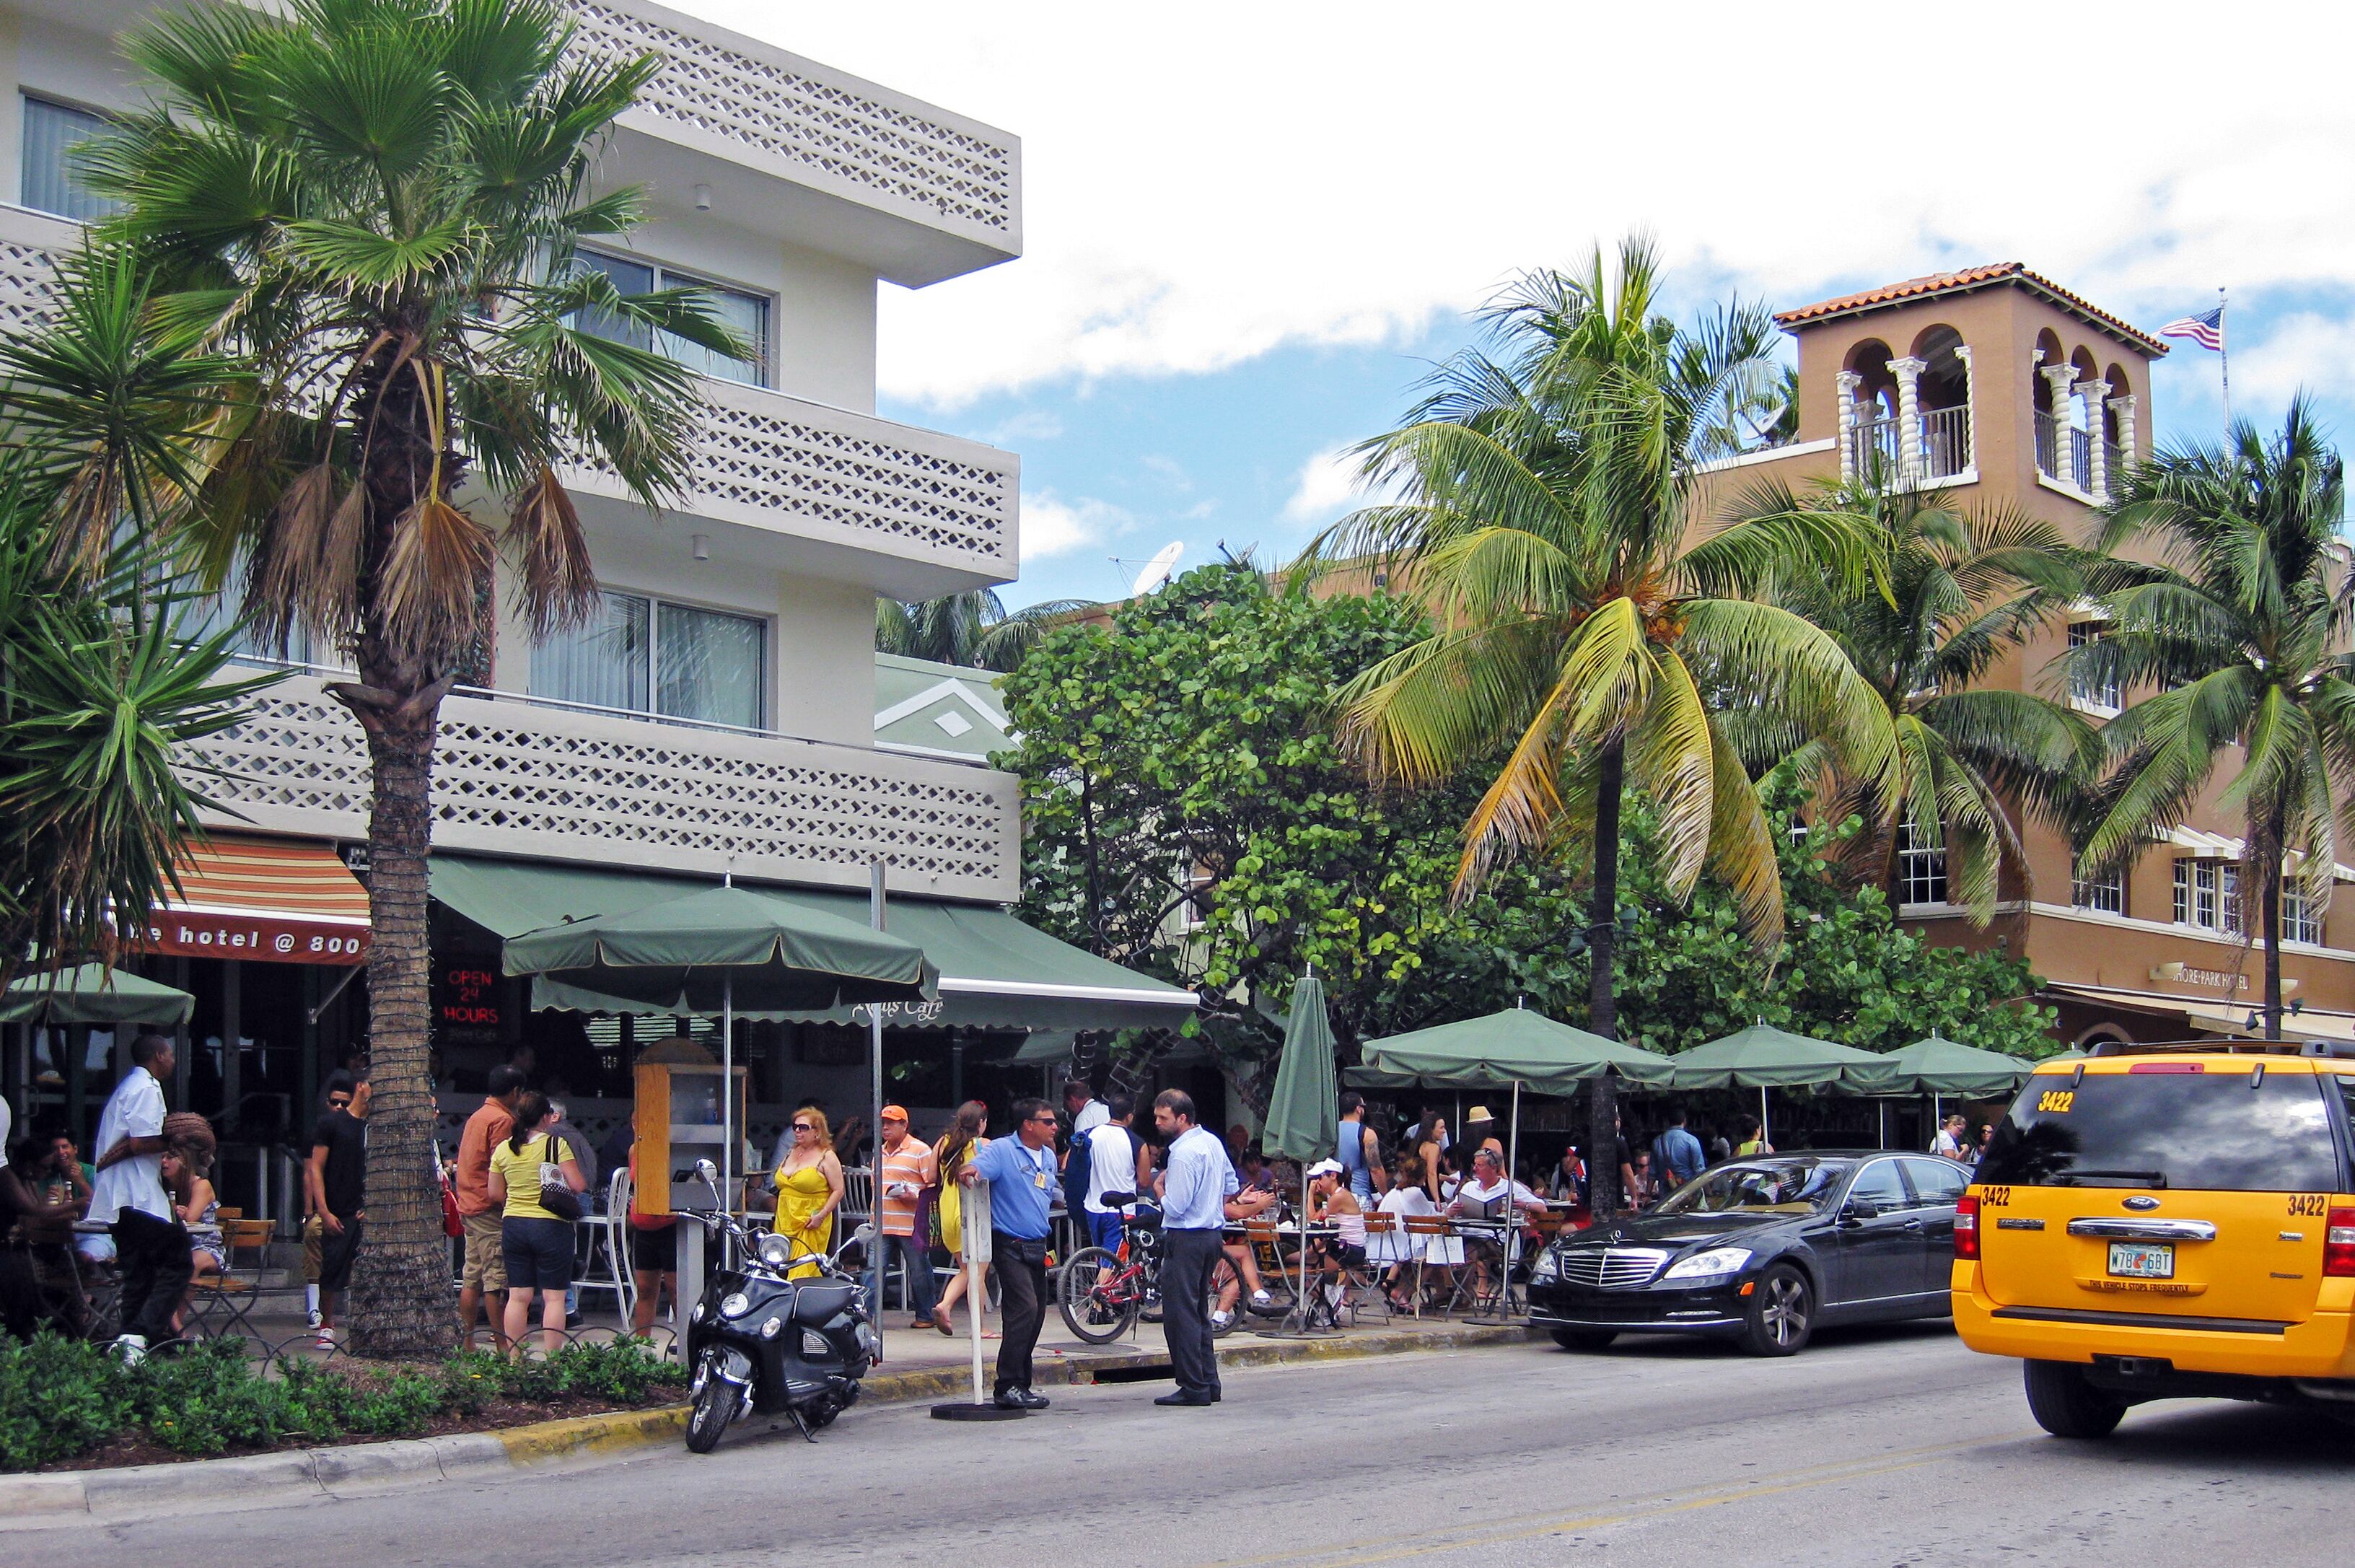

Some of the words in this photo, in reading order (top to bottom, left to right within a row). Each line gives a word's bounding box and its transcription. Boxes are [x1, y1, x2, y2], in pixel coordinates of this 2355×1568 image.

[179, 926, 259, 947] hotel
[274, 933, 295, 952] @
[309, 936, 360, 954] 800
[449, 971, 492, 986] OPEN
[461, 987, 479, 1002] 24
[444, 1006, 498, 1023] HOURS
[2038, 1090, 2074, 1112] 3422
[1982, 1186, 2010, 1206] 3422
[2287, 1195, 2325, 1216] 3422
[2112, 1252, 2133, 1269] W78
[2147, 1253, 2170, 1270] 6BT
[2089, 1279, 2101, 1289] THIS
[2128, 1283, 2148, 1292] STOPS
[2149, 1284, 2190, 1292] FREQUENTLY
